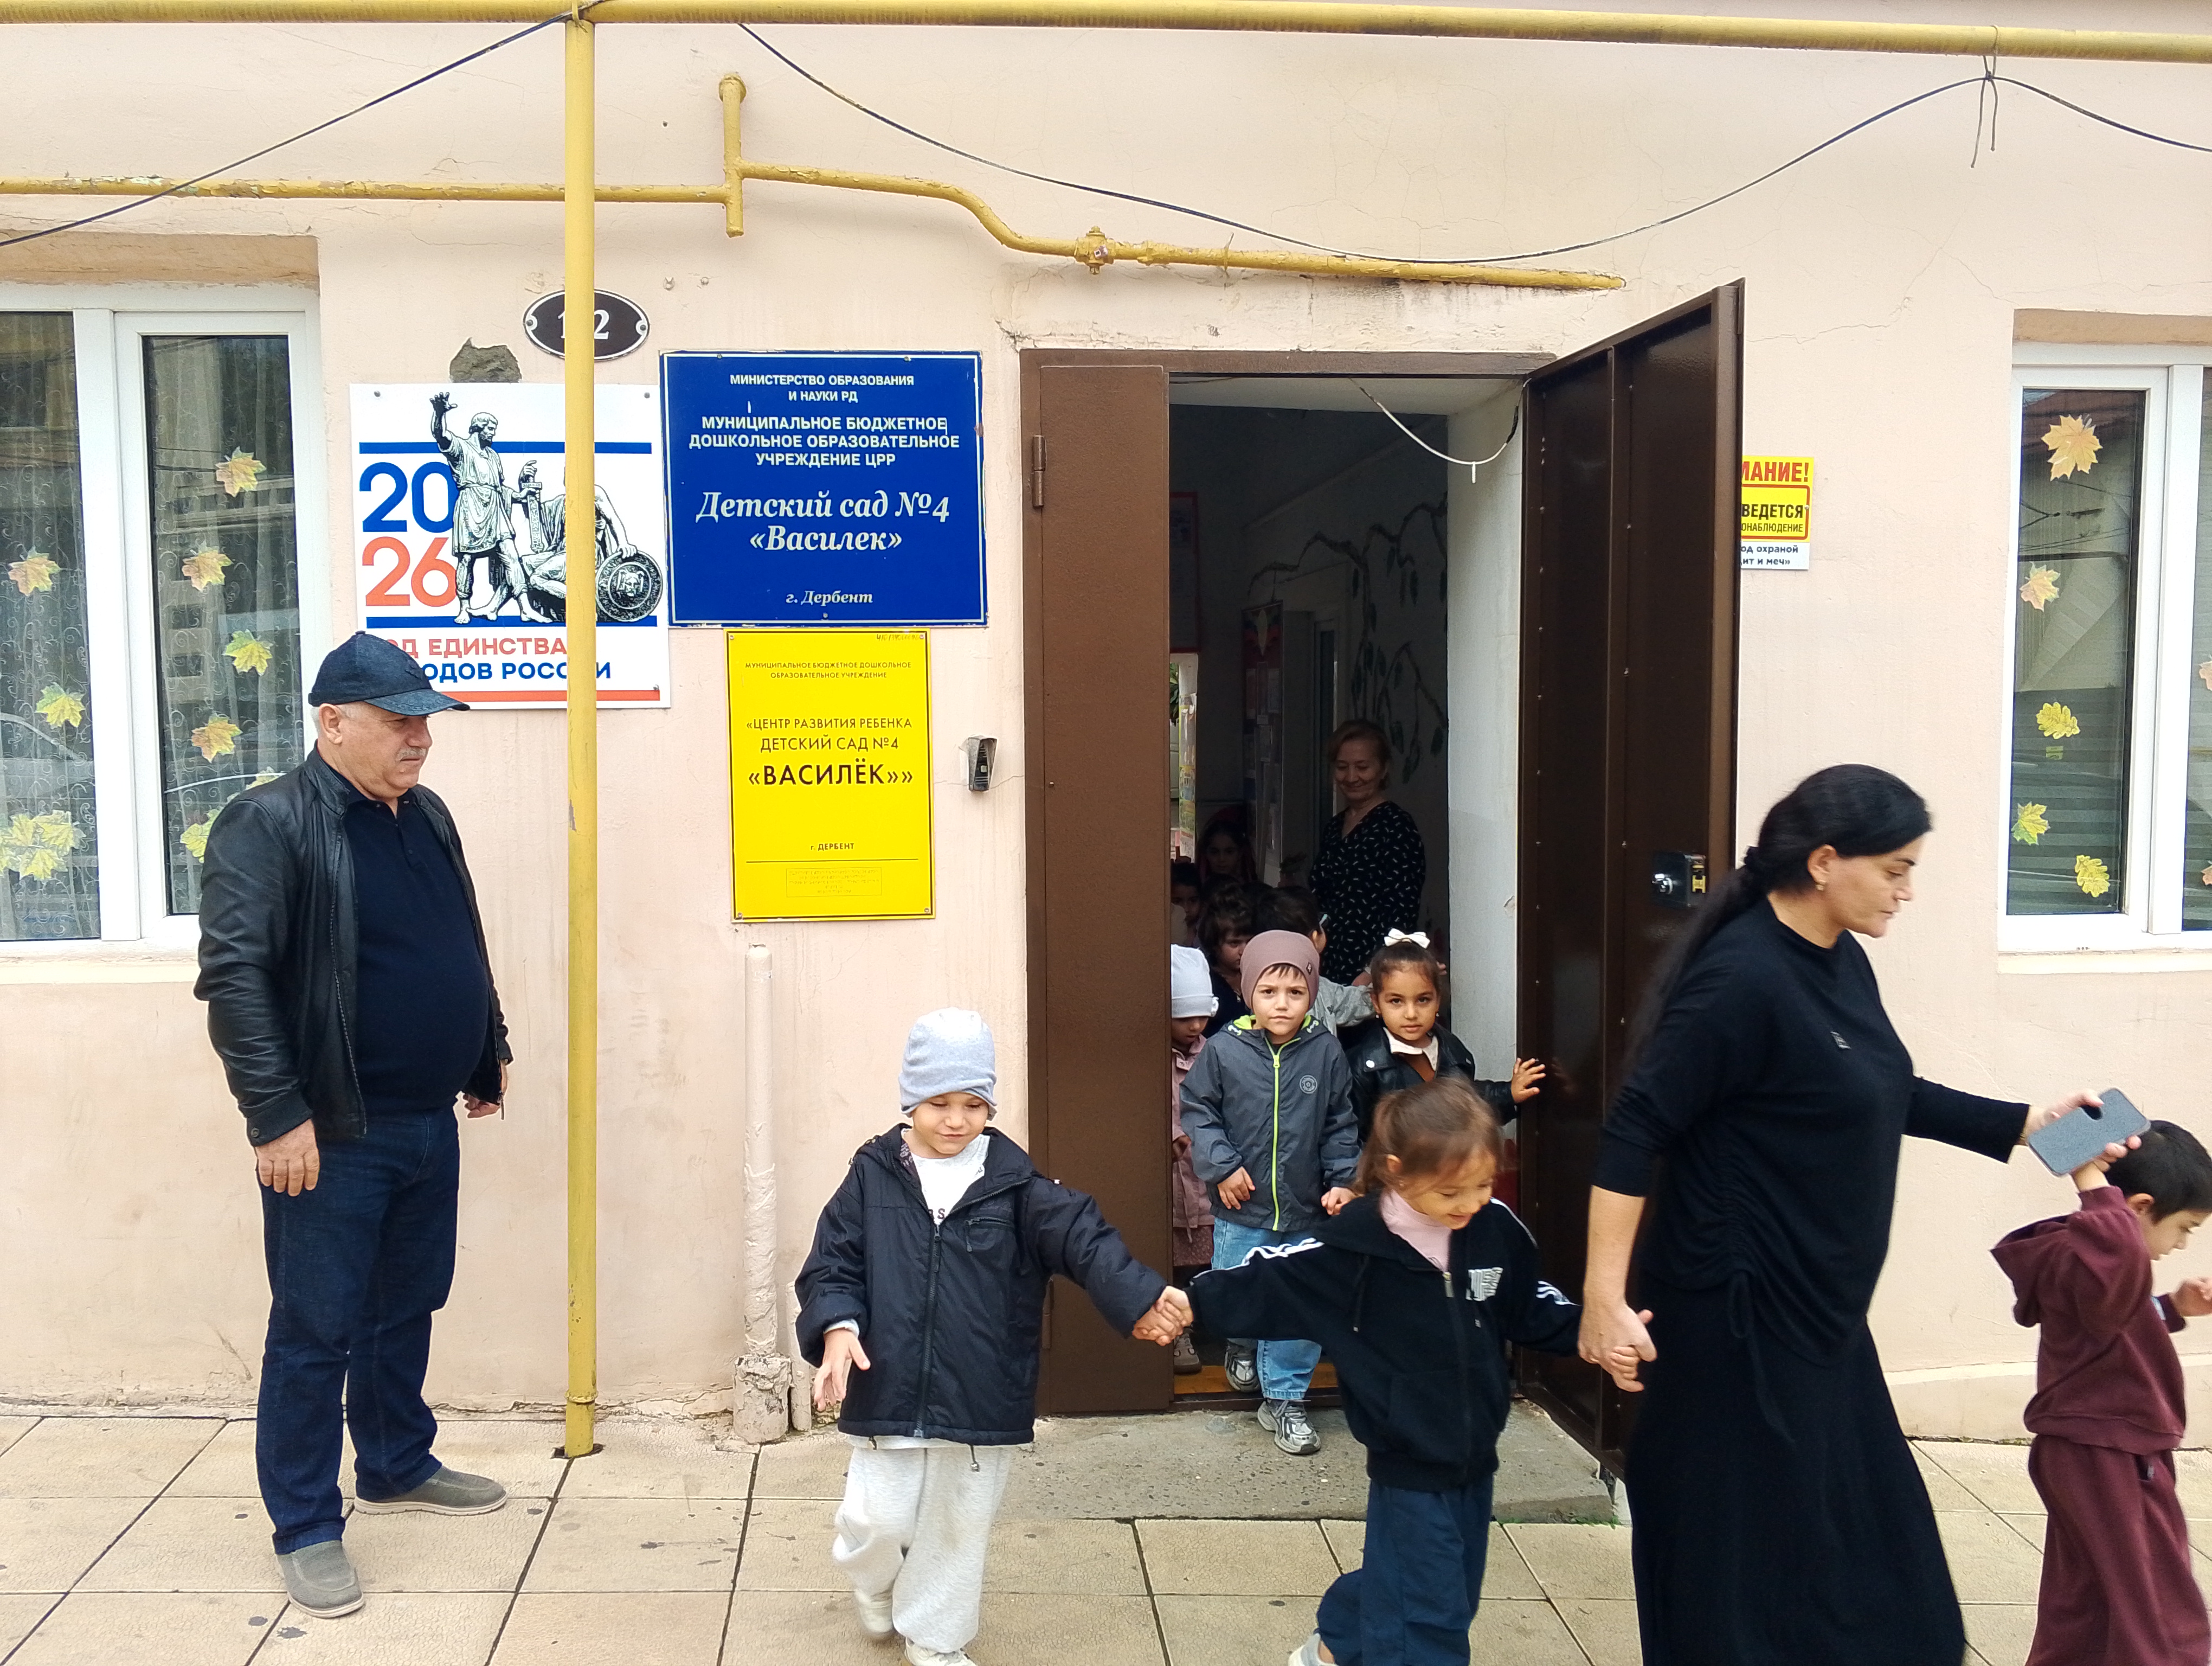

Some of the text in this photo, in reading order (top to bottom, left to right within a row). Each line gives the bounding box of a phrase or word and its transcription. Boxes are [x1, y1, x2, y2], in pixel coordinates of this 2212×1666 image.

[730, 375, 914, 385] МИНИСТЕРСТВО ОБРАЗОВАНИЯ
[789, 391, 858, 403] И НАУКИ РД
[702, 416, 946, 432] МУНИЦИПАЛЬНОЕ БЮДЖЕТНОЕ
[689, 434, 959, 449] ДОШКОЛЬНОЕ ОБРАЗОВАТЕЛЬНОЕ
[756, 453, 895, 468] УЧРЕЖДЕНИЕ ЦРР
[1742, 462, 1809, 482] МАНИЕ!
[359, 462, 456, 533] 20
[696, 490, 949, 523] Детский сад №4
[1742, 504, 1803, 520] ВЕДЕТСЯ
[1741, 523, 1803, 533] ОНАБЛЮДЕНИЕ
[751, 526, 902, 551] «Василек»
[1741, 544, 1798, 554] од охраной
[362, 536, 456, 606] 26
[786, 591, 873, 606] г. Дербент
[428, 638, 567, 658] ЕДИНСТВА
[422, 662, 610, 683] ОДОВ РОССИ
[747, 718, 912, 731] «ЦЕНТР РАЗВИТИЯ РЕБЕНКА
[761, 734, 898, 753] ДЕТСКИЙ САД №4
[749, 758, 912, 785] «ВАСИЛЁК»»
